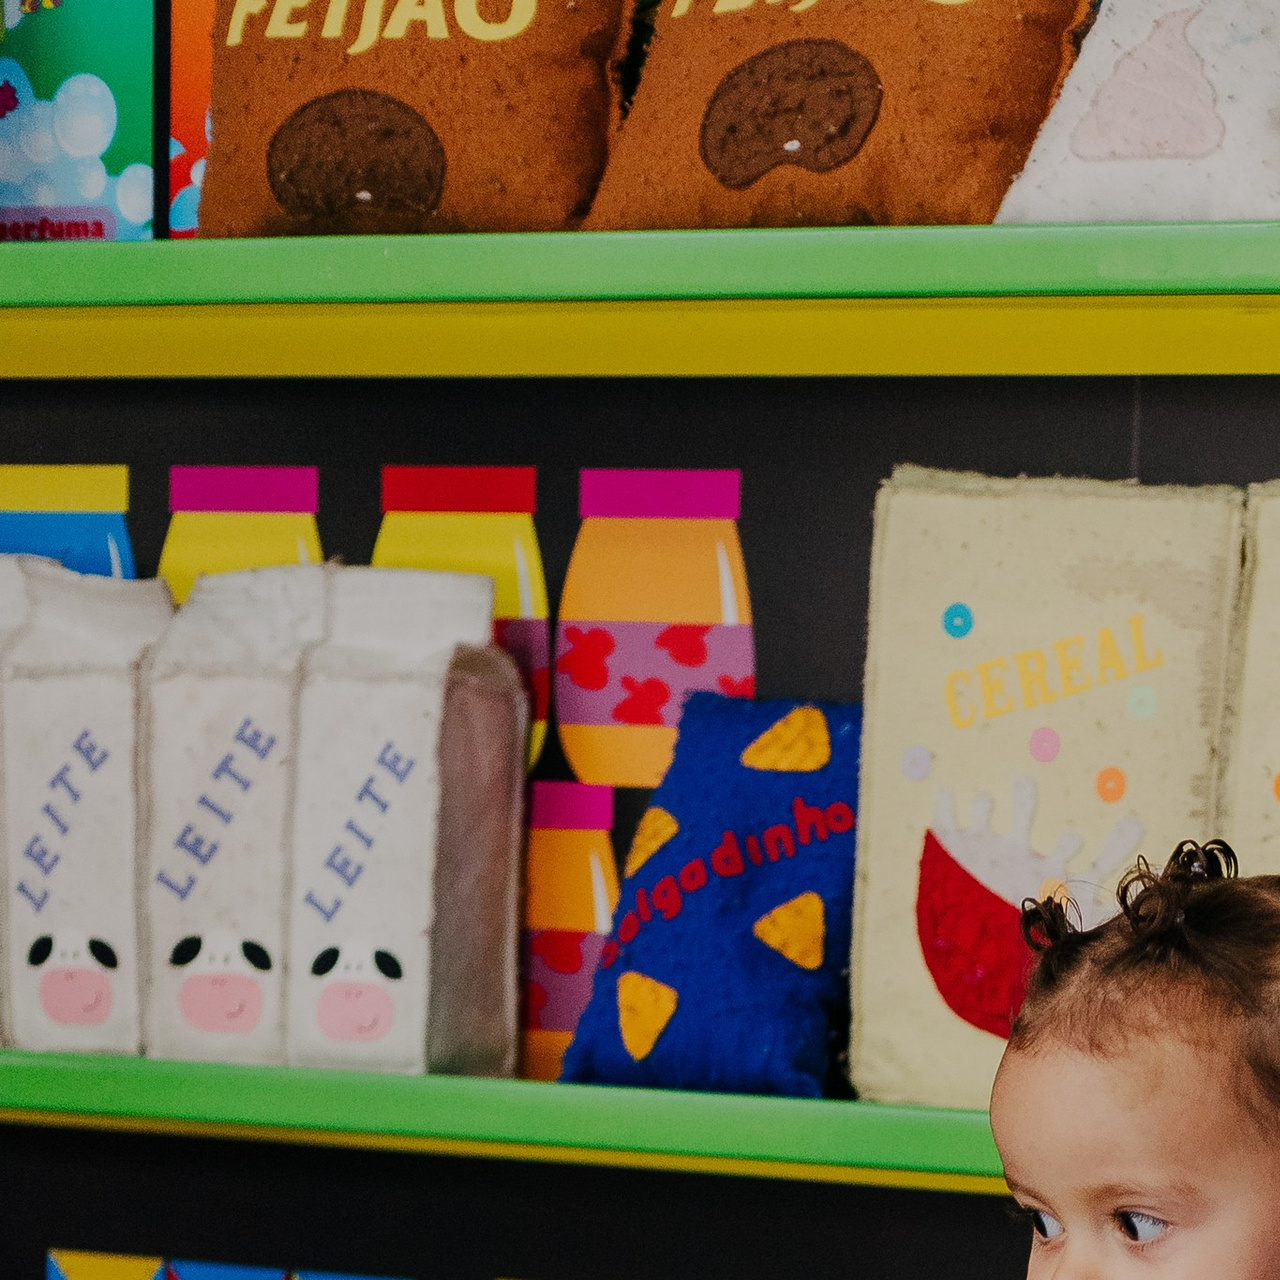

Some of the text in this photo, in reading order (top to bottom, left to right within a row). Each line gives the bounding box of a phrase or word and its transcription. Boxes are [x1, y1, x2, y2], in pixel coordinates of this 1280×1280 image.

[944, 614, 1164, 729] CEREAL
[17, 729, 110, 913] LEITE
[156, 716, 277, 901] LEITE
[304, 740, 416, 923] LEITE
